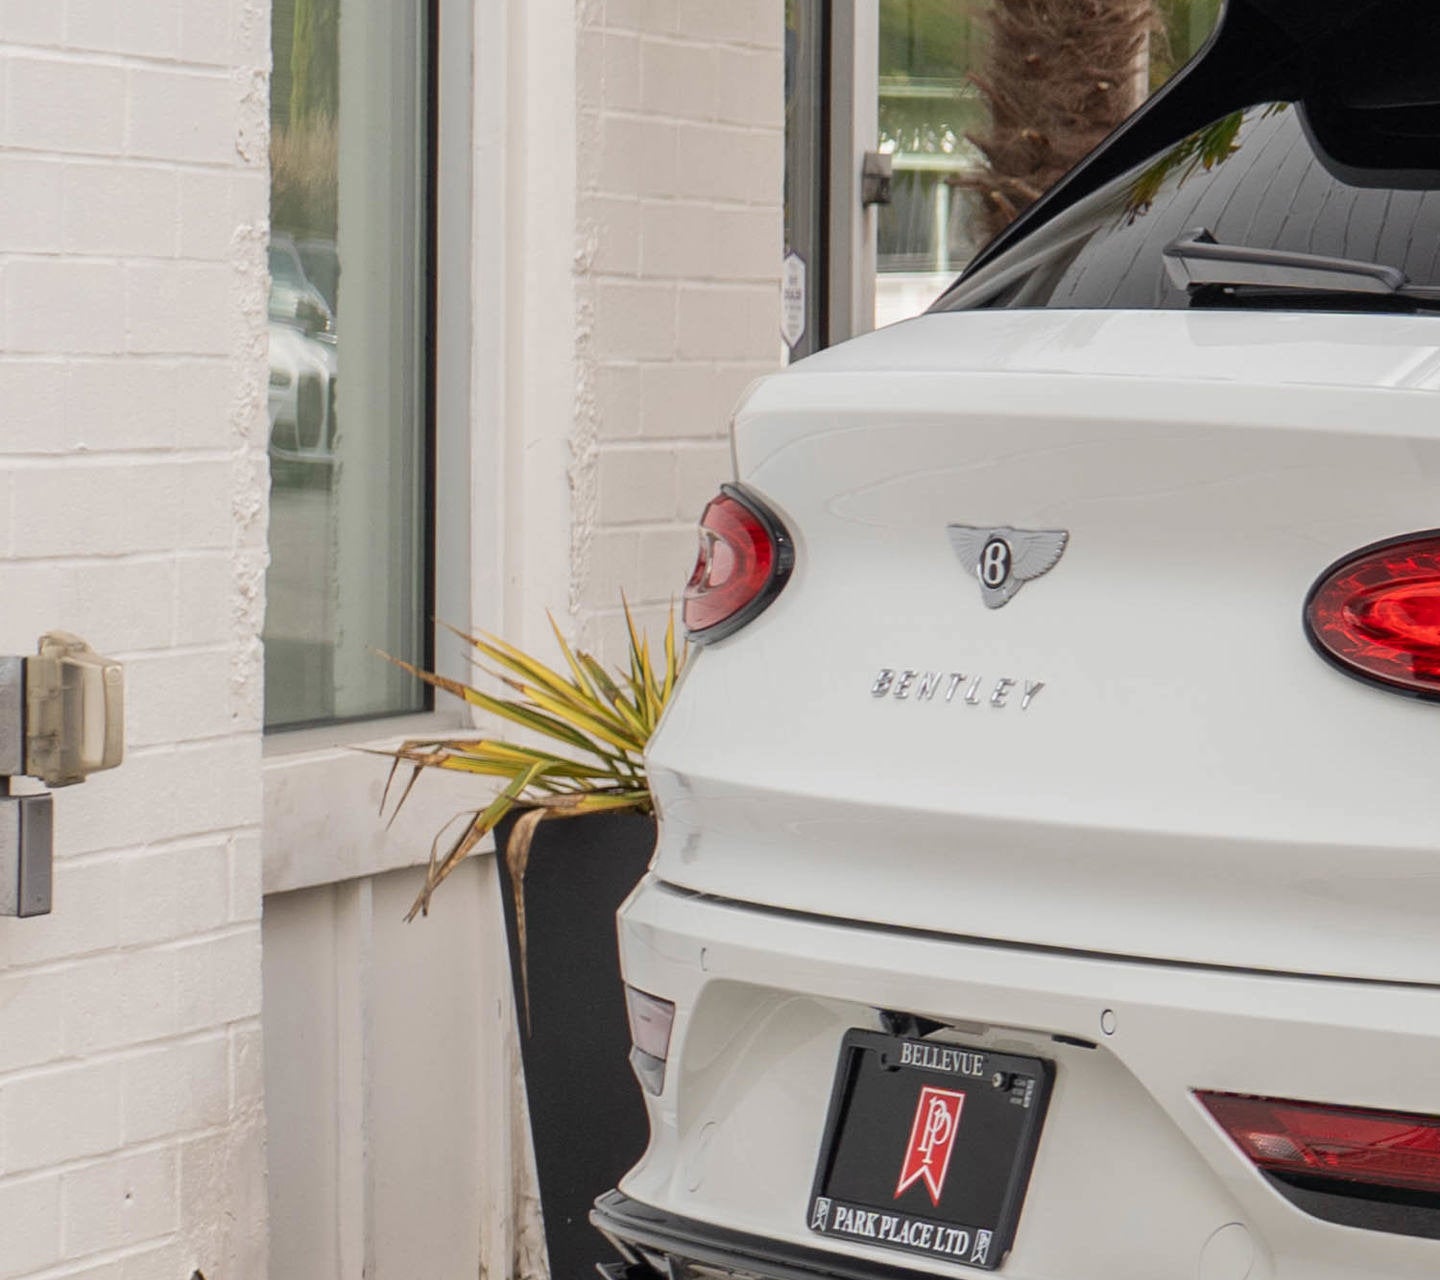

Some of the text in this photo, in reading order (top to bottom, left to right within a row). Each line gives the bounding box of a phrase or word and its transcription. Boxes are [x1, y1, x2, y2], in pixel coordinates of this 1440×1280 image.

[871, 669, 1045, 710] BENTLEY
[900, 1042, 984, 1076] BELLEVUE
[833, 1206, 877, 1238] PARK
[878, 1214, 933, 1249] PLACE
[933, 1227, 970, 1256] LTD
